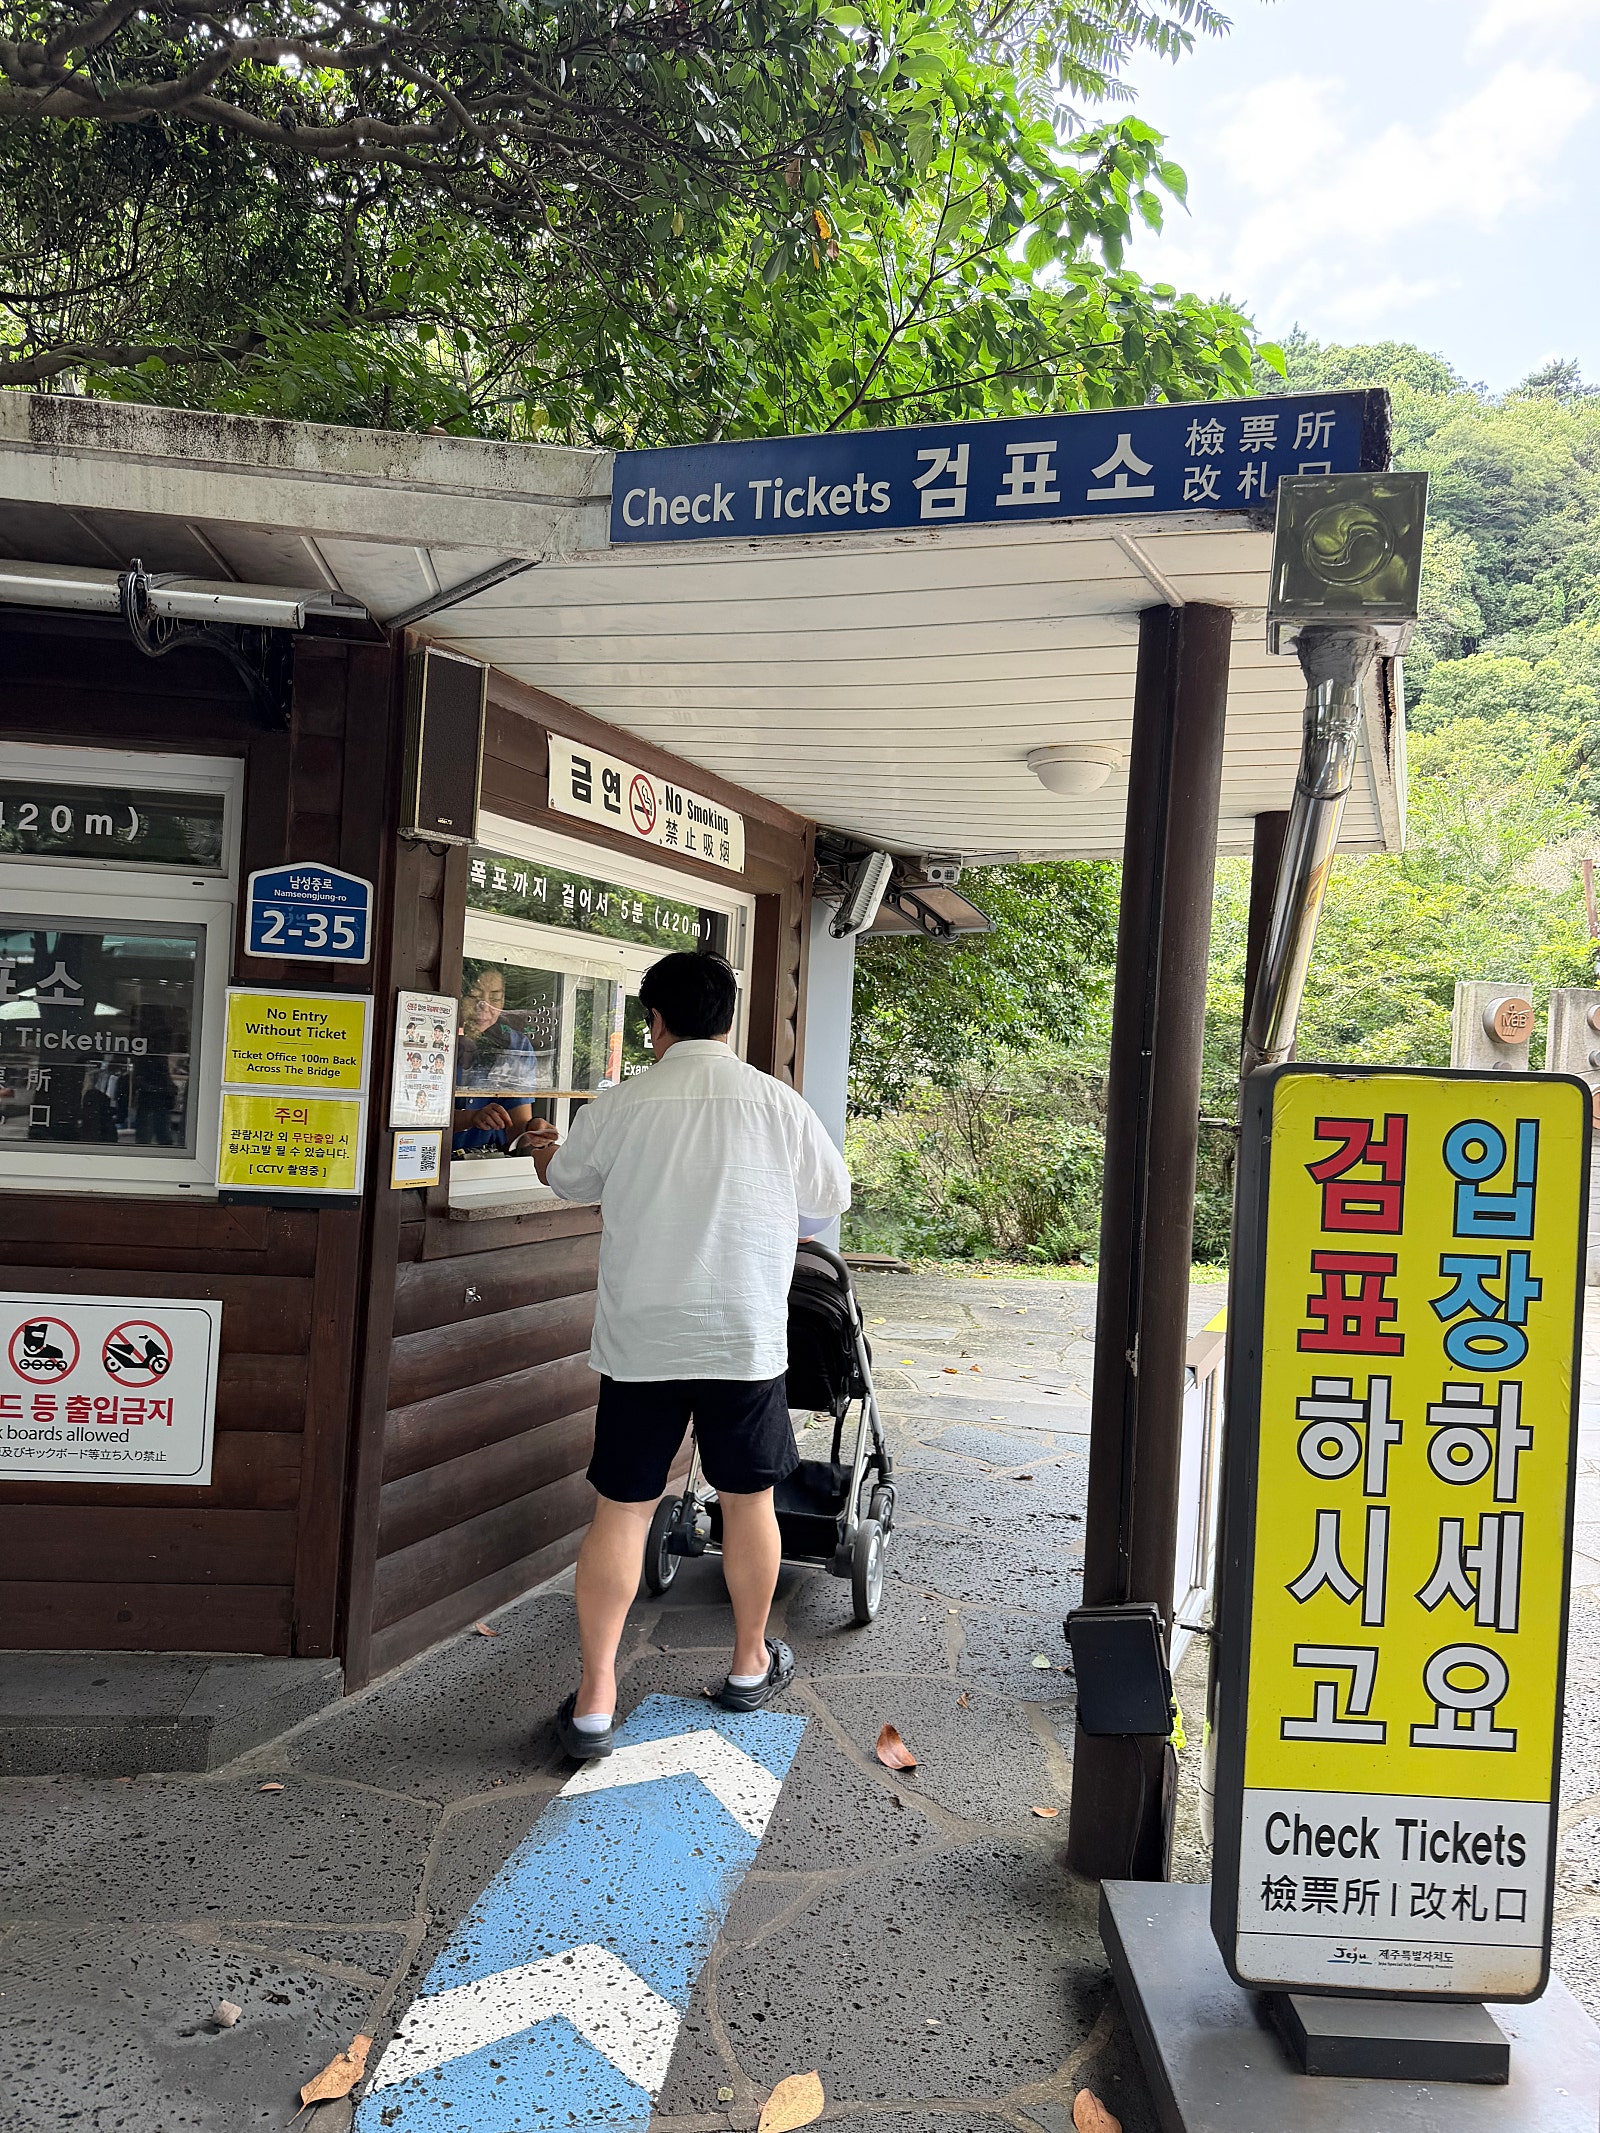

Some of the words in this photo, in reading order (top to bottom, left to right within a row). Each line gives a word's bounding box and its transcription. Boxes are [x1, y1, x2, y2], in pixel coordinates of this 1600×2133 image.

[1184, 409, 1336, 457] 檢票所
[912, 433, 1156, 519] 검표소
[622, 483, 736, 527] Check
[748, 473, 891, 519] Tickets
[571, 755, 621, 815] 금연
[665, 785, 683, 816] No
[687, 799, 729, 836] Smoking
[665, 818, 730, 864] 禁止吸烟
[274, 889, 347, 902] Namseongjung-ro
[289, 876, 334, 891] 남성중로
[470, 859, 547, 902] 폭포까지
[562, 883, 608, 916] 걸어서
[621, 902, 644, 924] 5분
[654, 906, 711, 940] (420m)
[261, 910, 355, 950] 2-35
[246, 1022, 302, 1037] Without
[306, 1027, 347, 1040] Ticket
[267, 1008, 287, 1020] No
[292, 1009, 328, 1025] Entry
[16, 1026, 148, 1056] Ticketing
[232, 1049, 263, 1060] Ticket
[266, 1051, 297, 1062] Office
[301, 1054, 329, 1064] 100m
[333, 1056, 357, 1066] Back
[246, 1063, 281, 1073] Across
[285, 1065, 304, 1075] The
[307, 1067, 341, 1079] Bridge
[274, 1107, 308, 1125] 주의
[228, 1143, 272, 1156] 형사고발
[275, 1145, 286, 1156] 될
[289, 1146, 301, 1157] 수
[304, 1147, 350, 1159] 있습니다.
[230, 1129, 274, 1142] 관람시간
[277, 1131, 288, 1142] 외
[292, 1132, 334, 1145] 무단출입
[338, 1135, 349, 1145] 시
[256, 1164, 285, 1174] CCTV
[287, 1165, 319, 1176] 촬영중
[30, 1393, 59, 1423] 등
[65, 1395, 174, 1426] 출입금지
[7, 1425, 63, 1441] boards
[66, 1428, 130, 1443] allowed
[1280, 1113, 1408, 1745] 검표하시고
[1408, 1118, 1543, 1752] 입장하세요
[1264, 1811, 1380, 1860] Check
[1395, 1818, 1527, 1867] Tickets
[1378, 1949, 1455, 1963] 제주특별자치도
